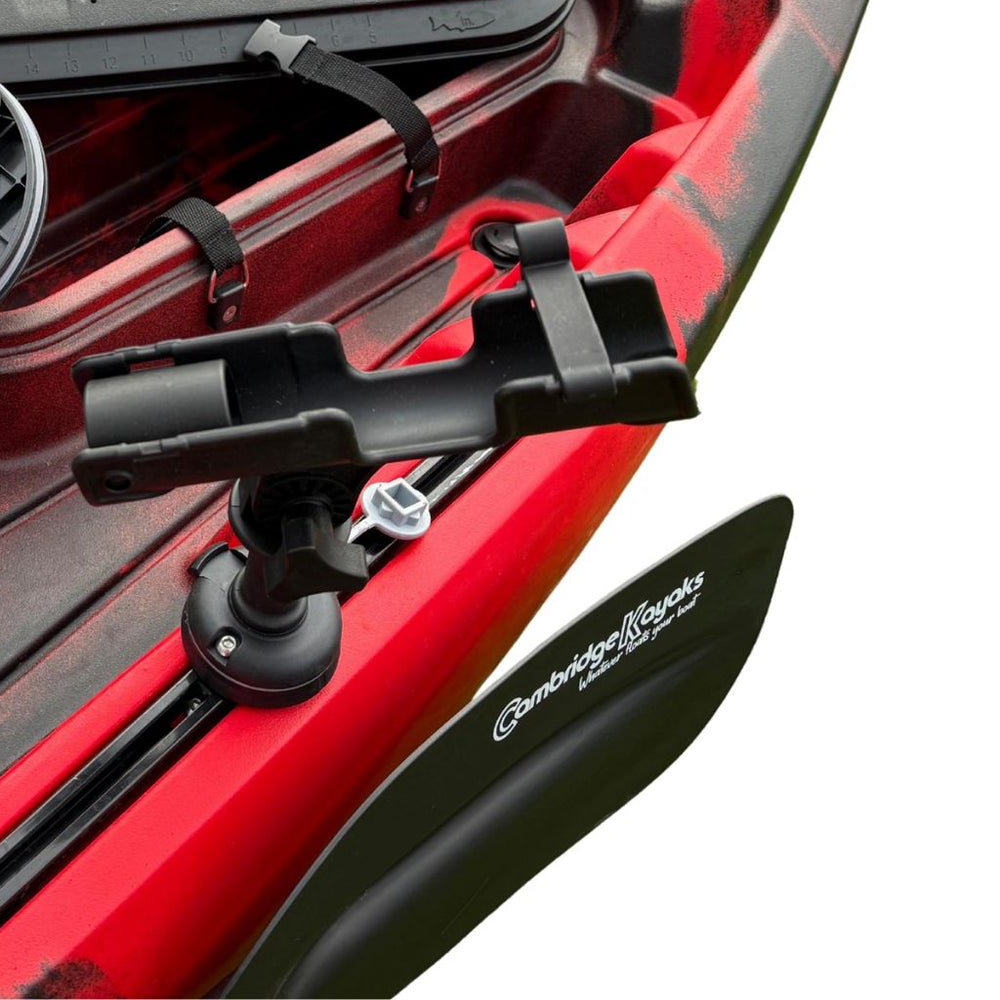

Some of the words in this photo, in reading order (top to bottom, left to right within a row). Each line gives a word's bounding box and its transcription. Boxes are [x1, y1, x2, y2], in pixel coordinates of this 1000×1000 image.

[24, 63, 40, 75] 14
[63, 59, 79, 73] 13
[102, 56, 118, 69] 12
[141, 54, 156, 66] 11
[178, 49, 193, 62] 10
[651, 615, 674, 641] your
[677, 592, 702, 619] boat
